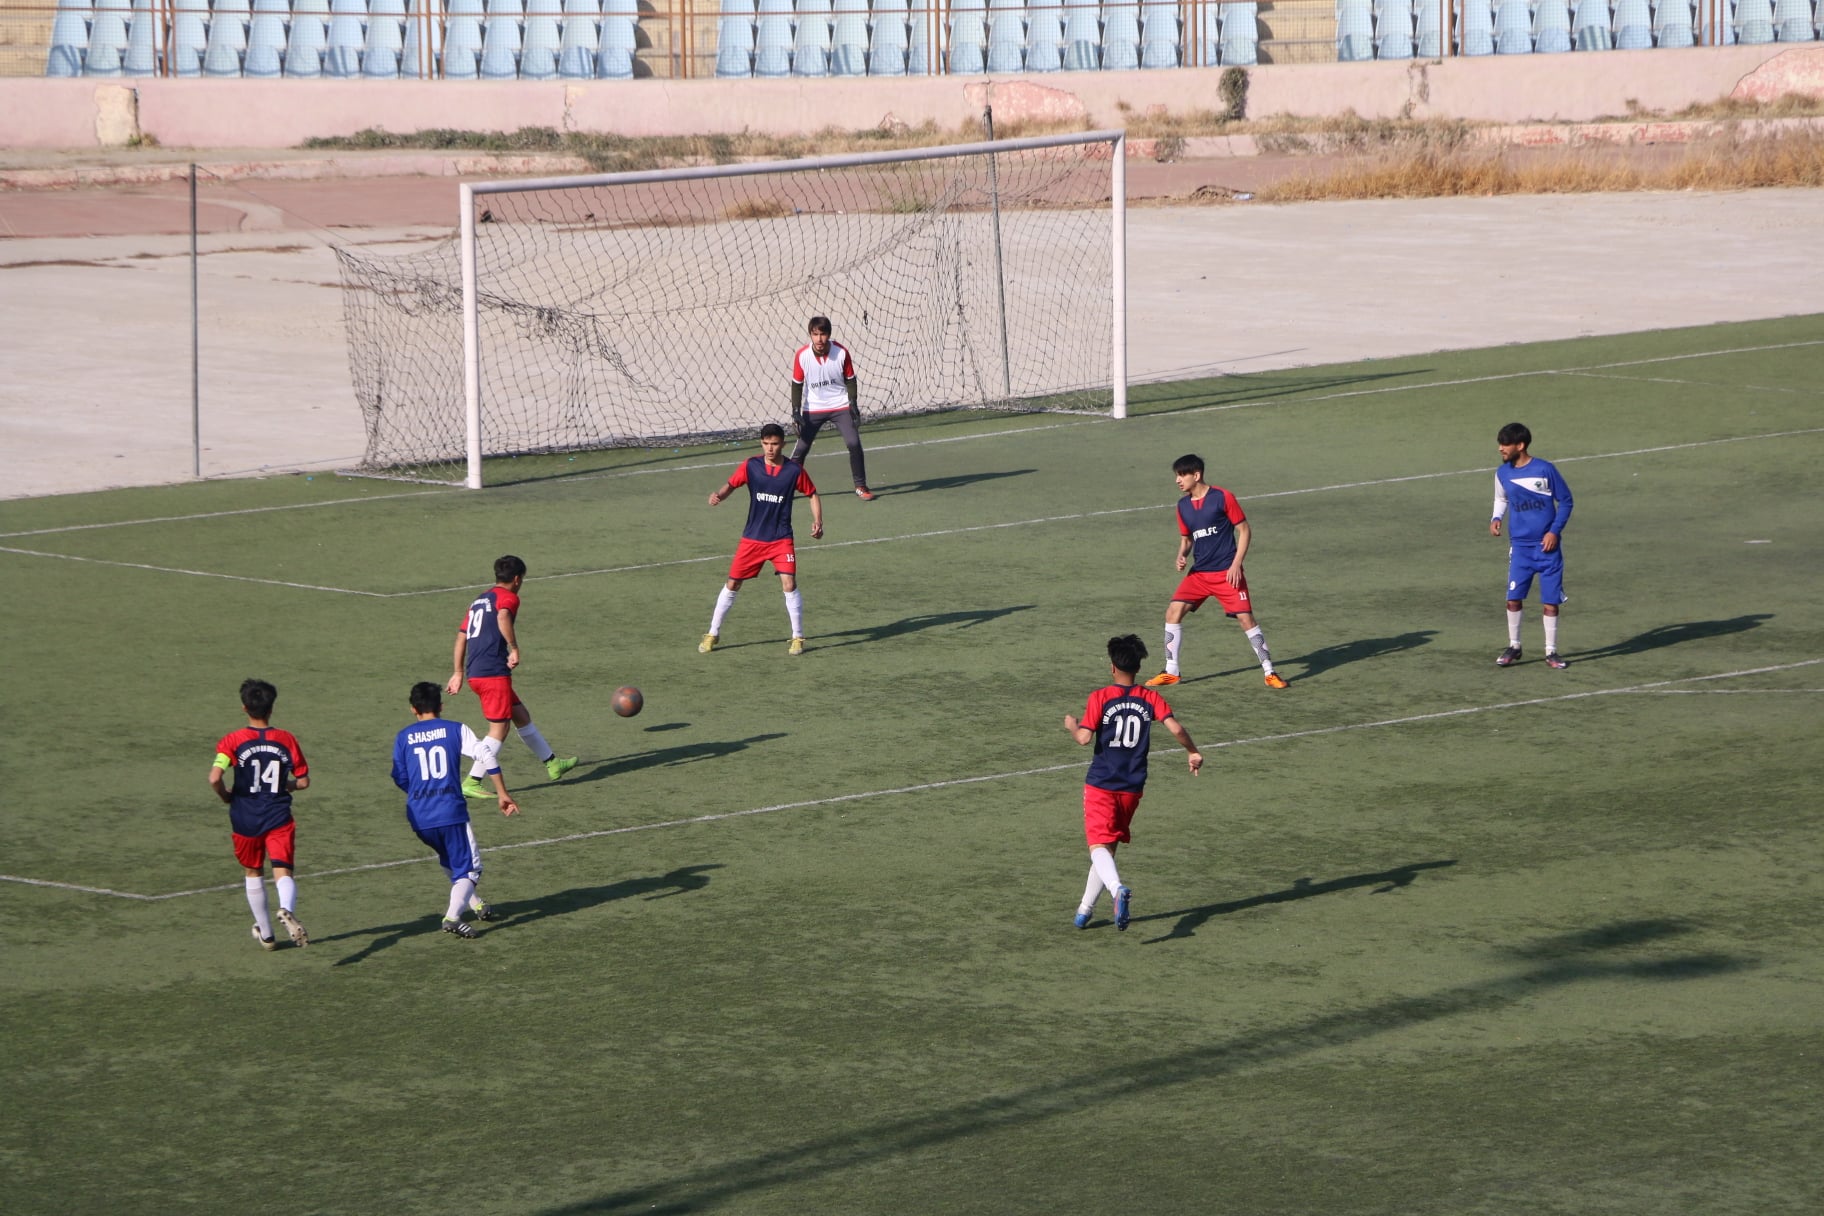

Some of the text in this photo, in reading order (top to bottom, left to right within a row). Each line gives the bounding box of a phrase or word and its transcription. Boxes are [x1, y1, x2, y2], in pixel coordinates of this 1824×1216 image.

[786, 554, 794, 562] 15
[1239, 592, 1247, 601] 11
[1510, 581, 1516, 590] 9
[467, 608, 484, 640] 19
[408, 728, 447, 745] S.HASHMI
[1109, 714, 1141, 748] 10
[414, 745, 448, 780] 10
[249, 759, 280, 793] 14
